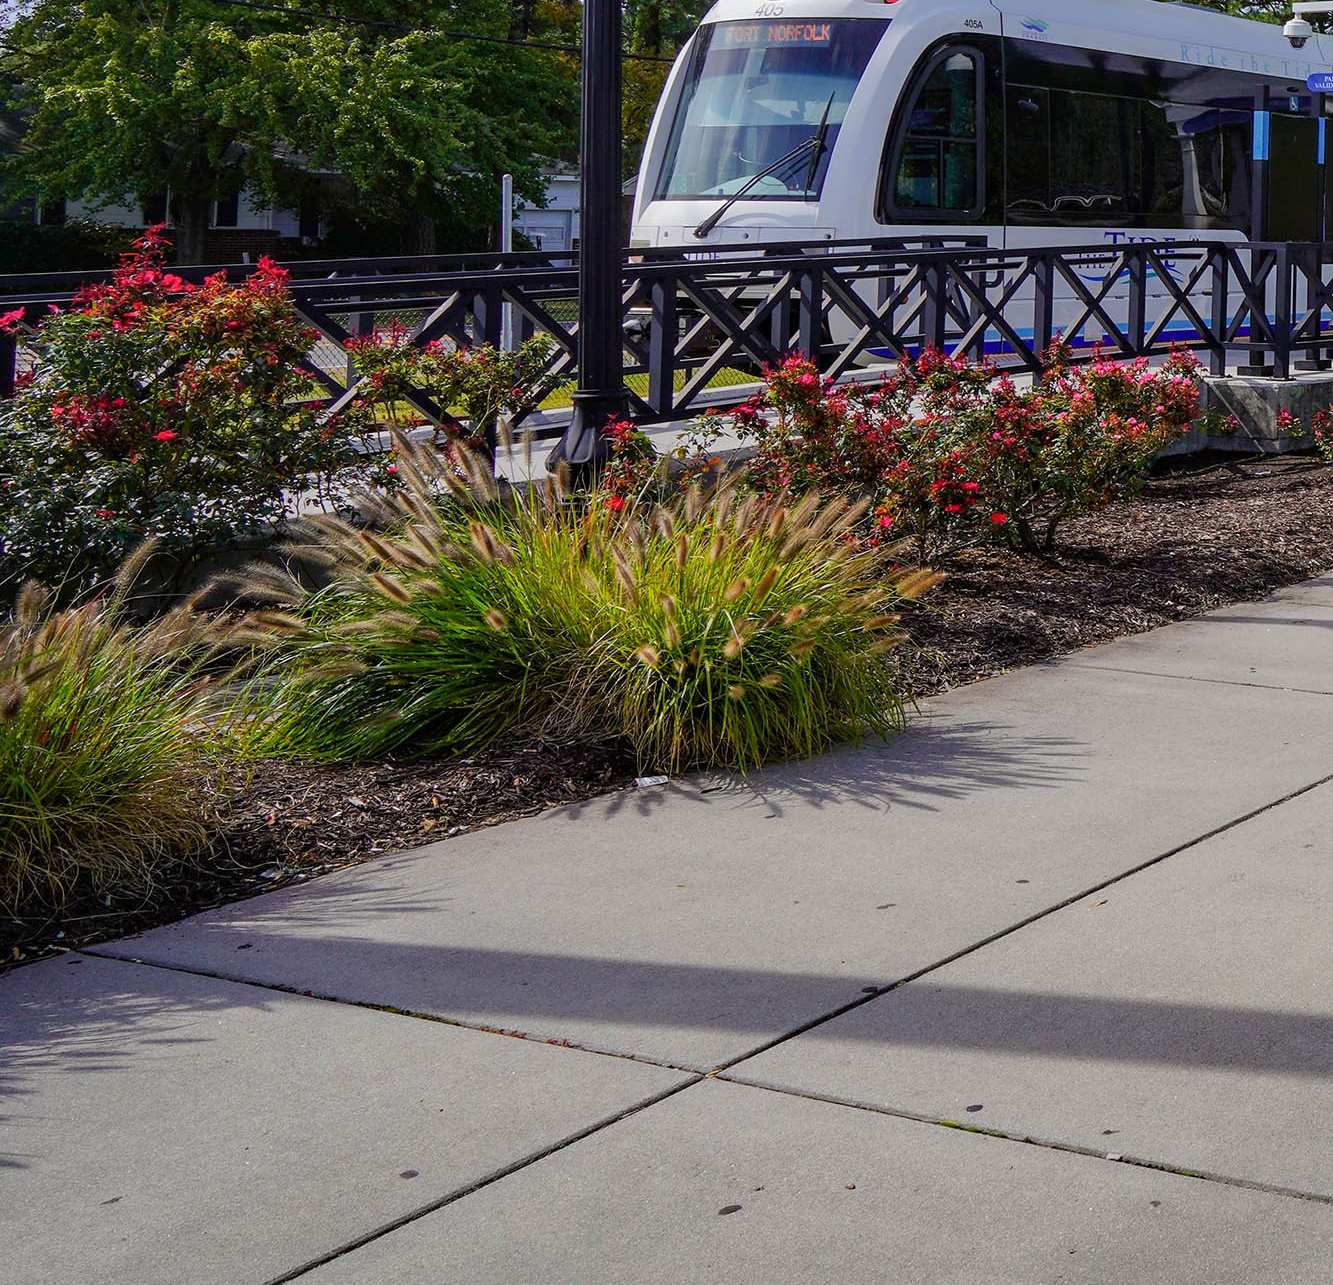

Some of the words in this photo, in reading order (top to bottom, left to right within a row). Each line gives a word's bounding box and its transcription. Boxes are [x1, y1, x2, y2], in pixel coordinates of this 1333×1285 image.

[755, 3, 784, 17] 405
[964, 19, 984, 29] 405A
[725, 25, 761, 44] FORT
[767, 24, 831, 43] NORFOLK
